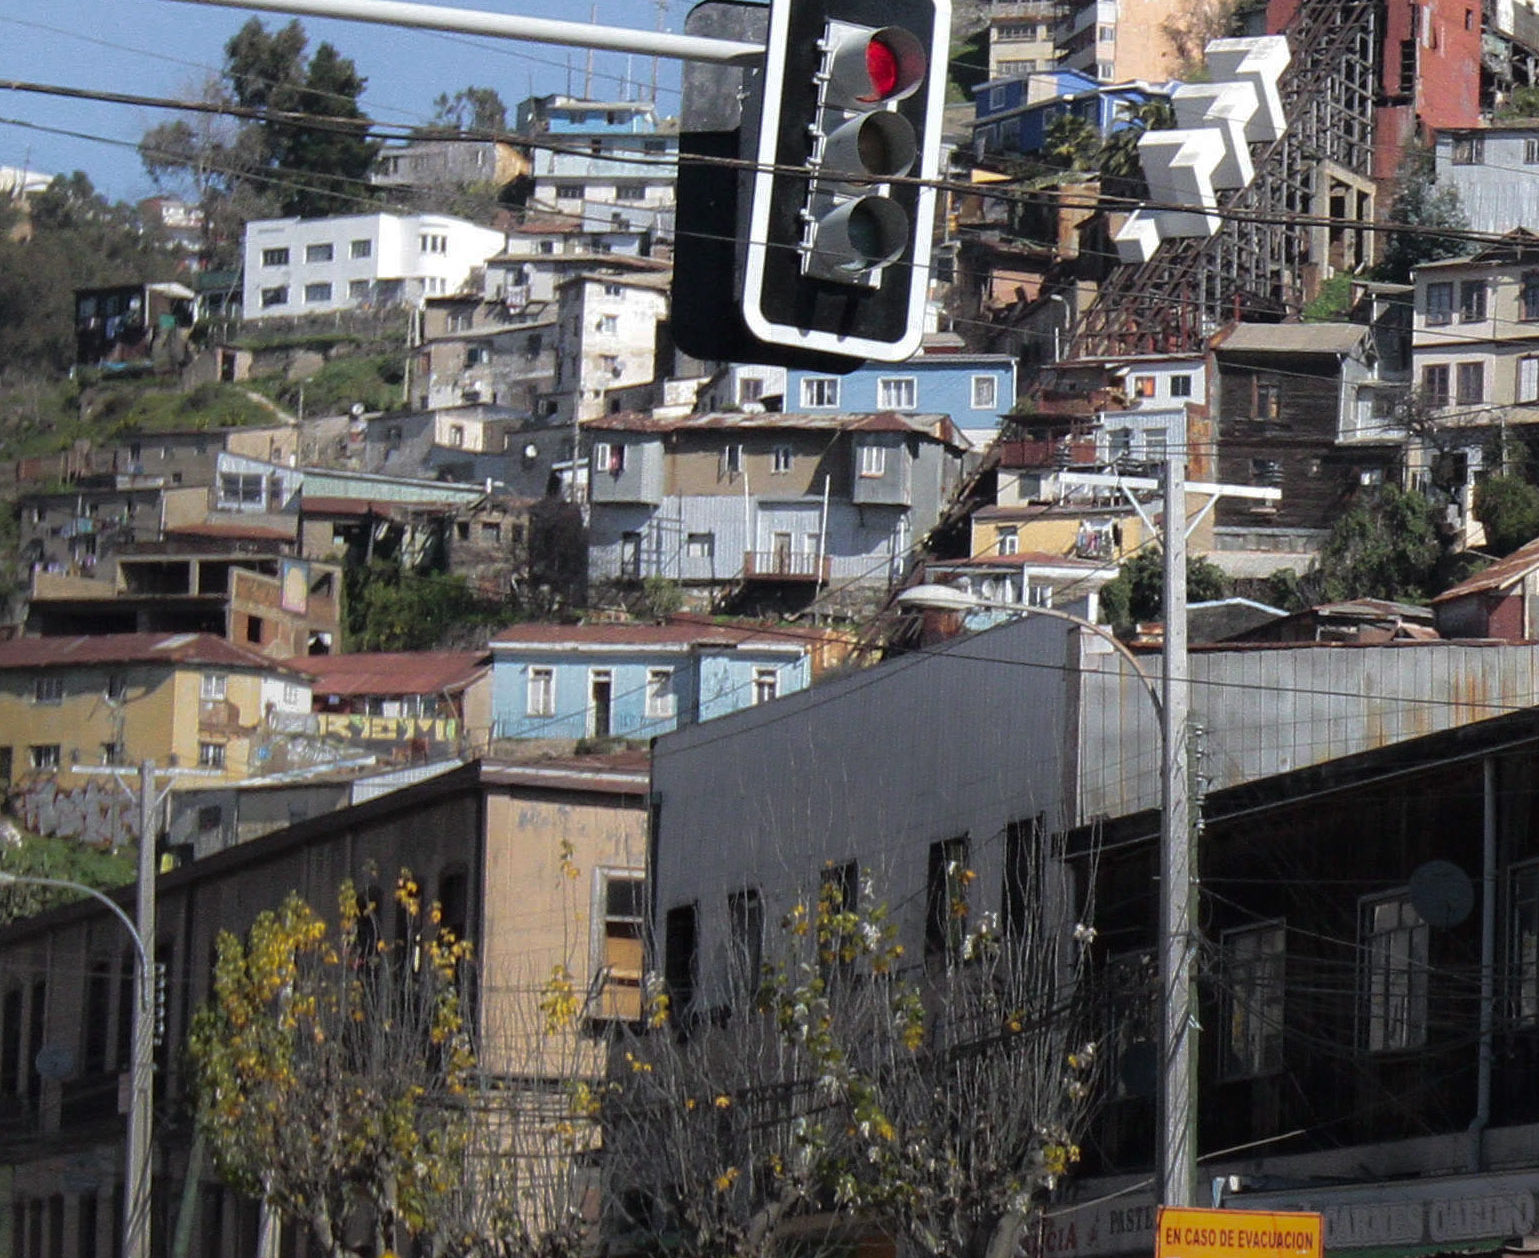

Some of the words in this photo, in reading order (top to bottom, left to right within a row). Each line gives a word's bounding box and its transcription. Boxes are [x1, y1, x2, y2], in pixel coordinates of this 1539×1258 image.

[1166, 1228, 1181, 1245] EN
[1185, 1229, 1216, 1247] CASO
[1220, 1230, 1235, 1248] DE
[1238, 1230, 1313, 1250] EVACUACION
